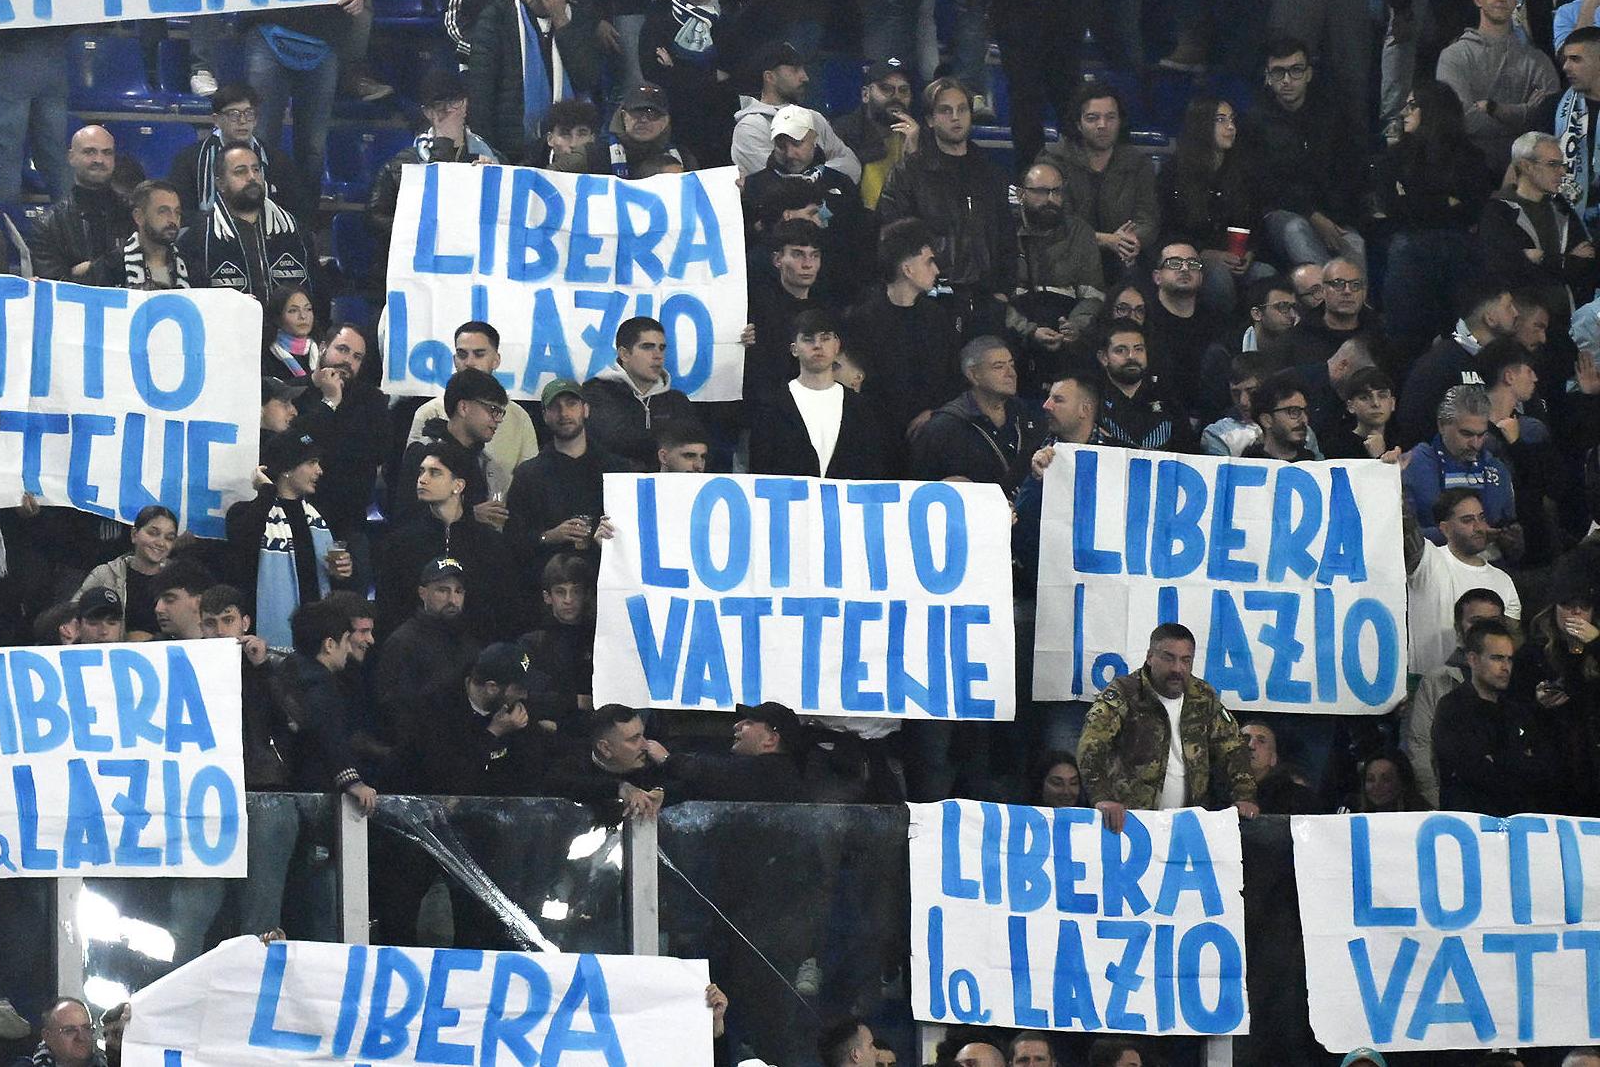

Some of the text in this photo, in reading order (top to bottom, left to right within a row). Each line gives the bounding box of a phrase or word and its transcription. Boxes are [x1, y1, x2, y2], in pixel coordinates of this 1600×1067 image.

[413, 164, 727, 285] LIBERA
[388, 285, 714, 396] la AZO
[637, 477, 968, 594] LOTITO
[1073, 450, 1367, 585] LIBERA
[627, 595, 995, 719] VATTENE
[1072, 584, 1129, 695] la
[13, 758, 239, 870] LAZIO
[942, 801, 1224, 917] LIBERA
[249, 940, 627, 1067] LIBERA
[928, 906, 1244, 1034] la LAZIO
